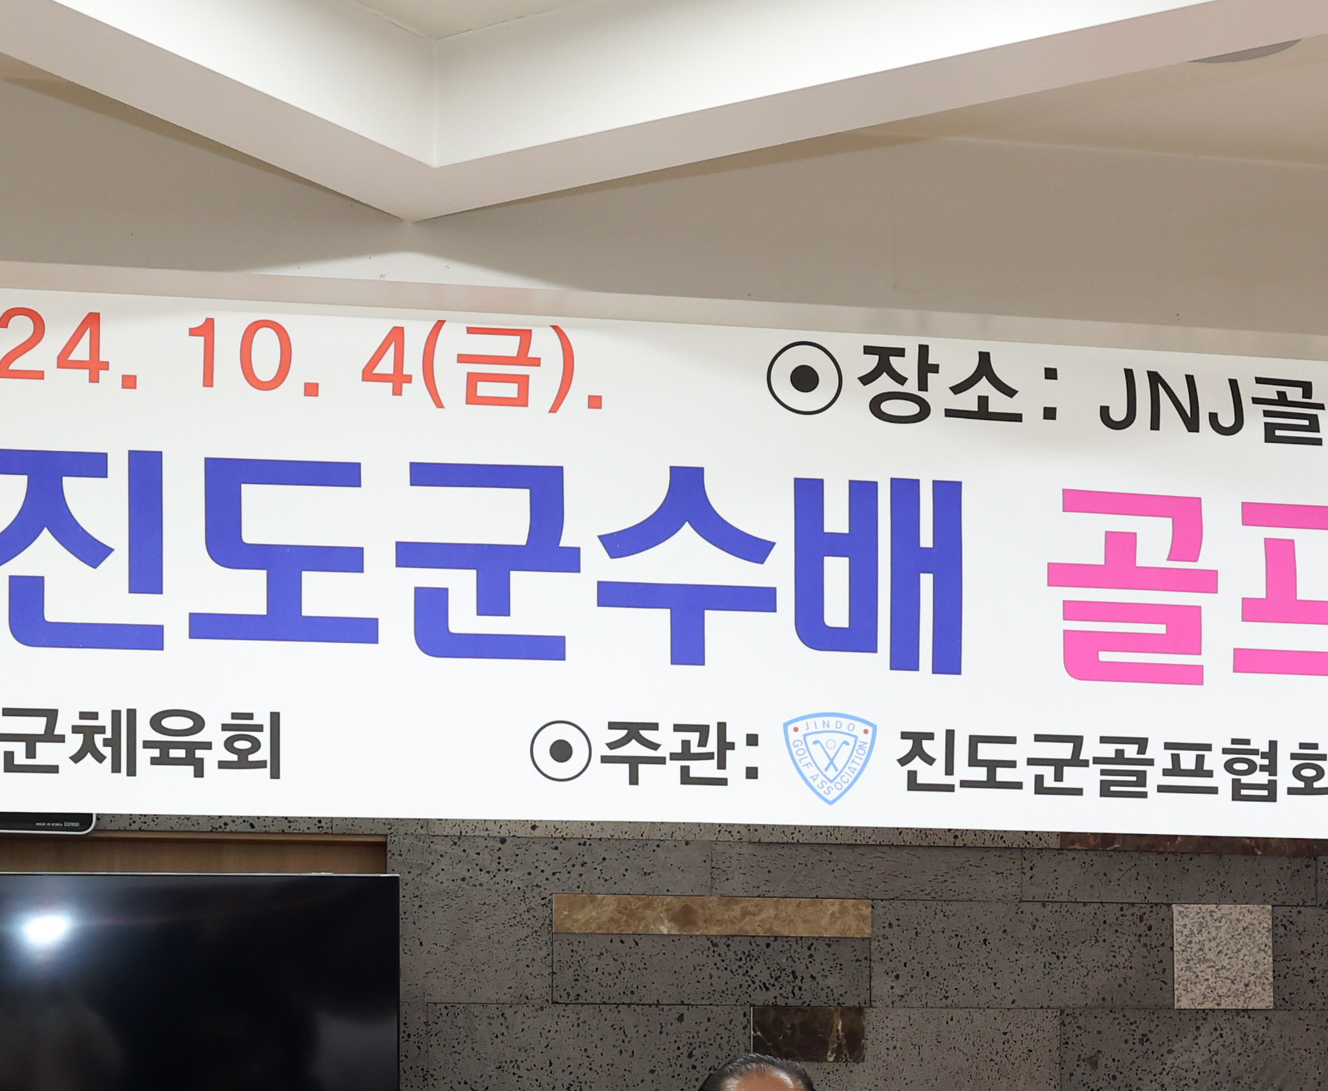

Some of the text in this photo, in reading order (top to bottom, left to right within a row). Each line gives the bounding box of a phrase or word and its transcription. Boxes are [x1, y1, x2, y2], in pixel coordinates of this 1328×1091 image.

[189, 317, 320, 397] 10.
[362, 319, 603, 414] 4(금).
[857, 344, 1059, 425] 장소:
[599, 720, 759, 787] 주관:
[792, 739, 814, 770] GOLF
[804, 719, 856, 732] JINDO
